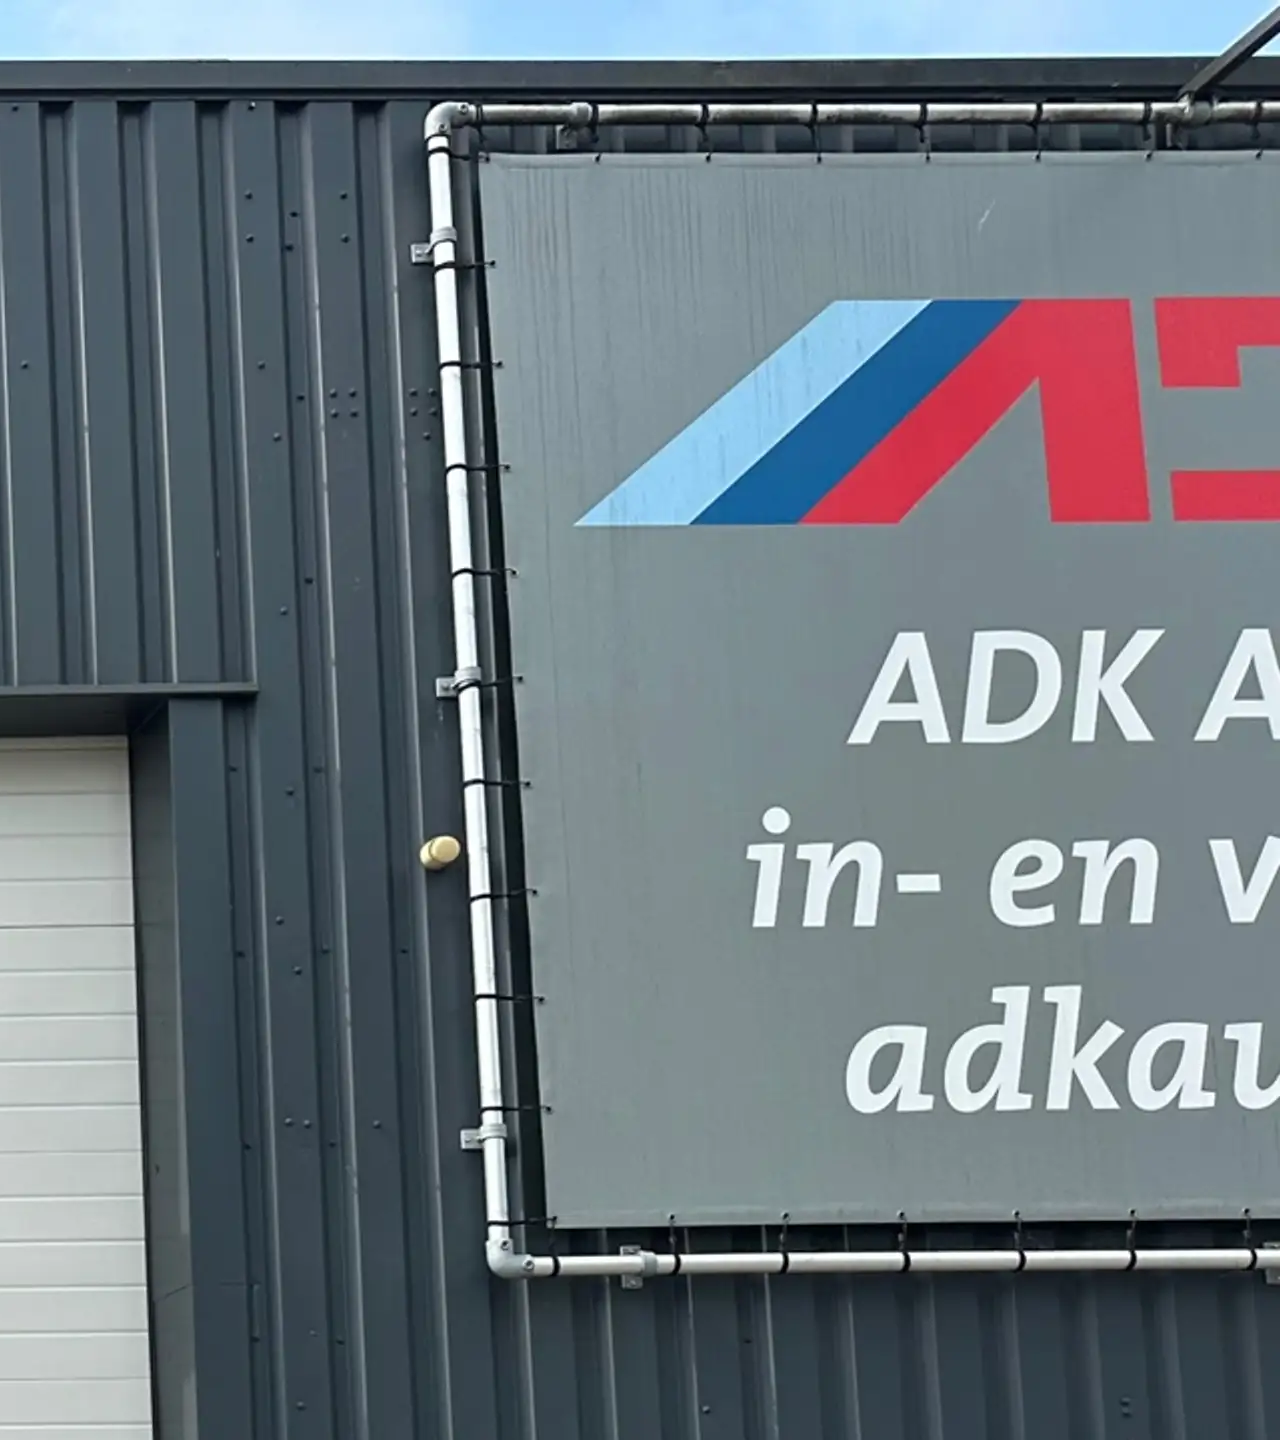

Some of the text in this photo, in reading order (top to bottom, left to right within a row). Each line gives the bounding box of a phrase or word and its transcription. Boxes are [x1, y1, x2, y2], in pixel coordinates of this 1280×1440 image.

[846, 628, 1166, 744] ADK
[745, 806, 941, 927] in-
[989, 837, 1159, 927] en
